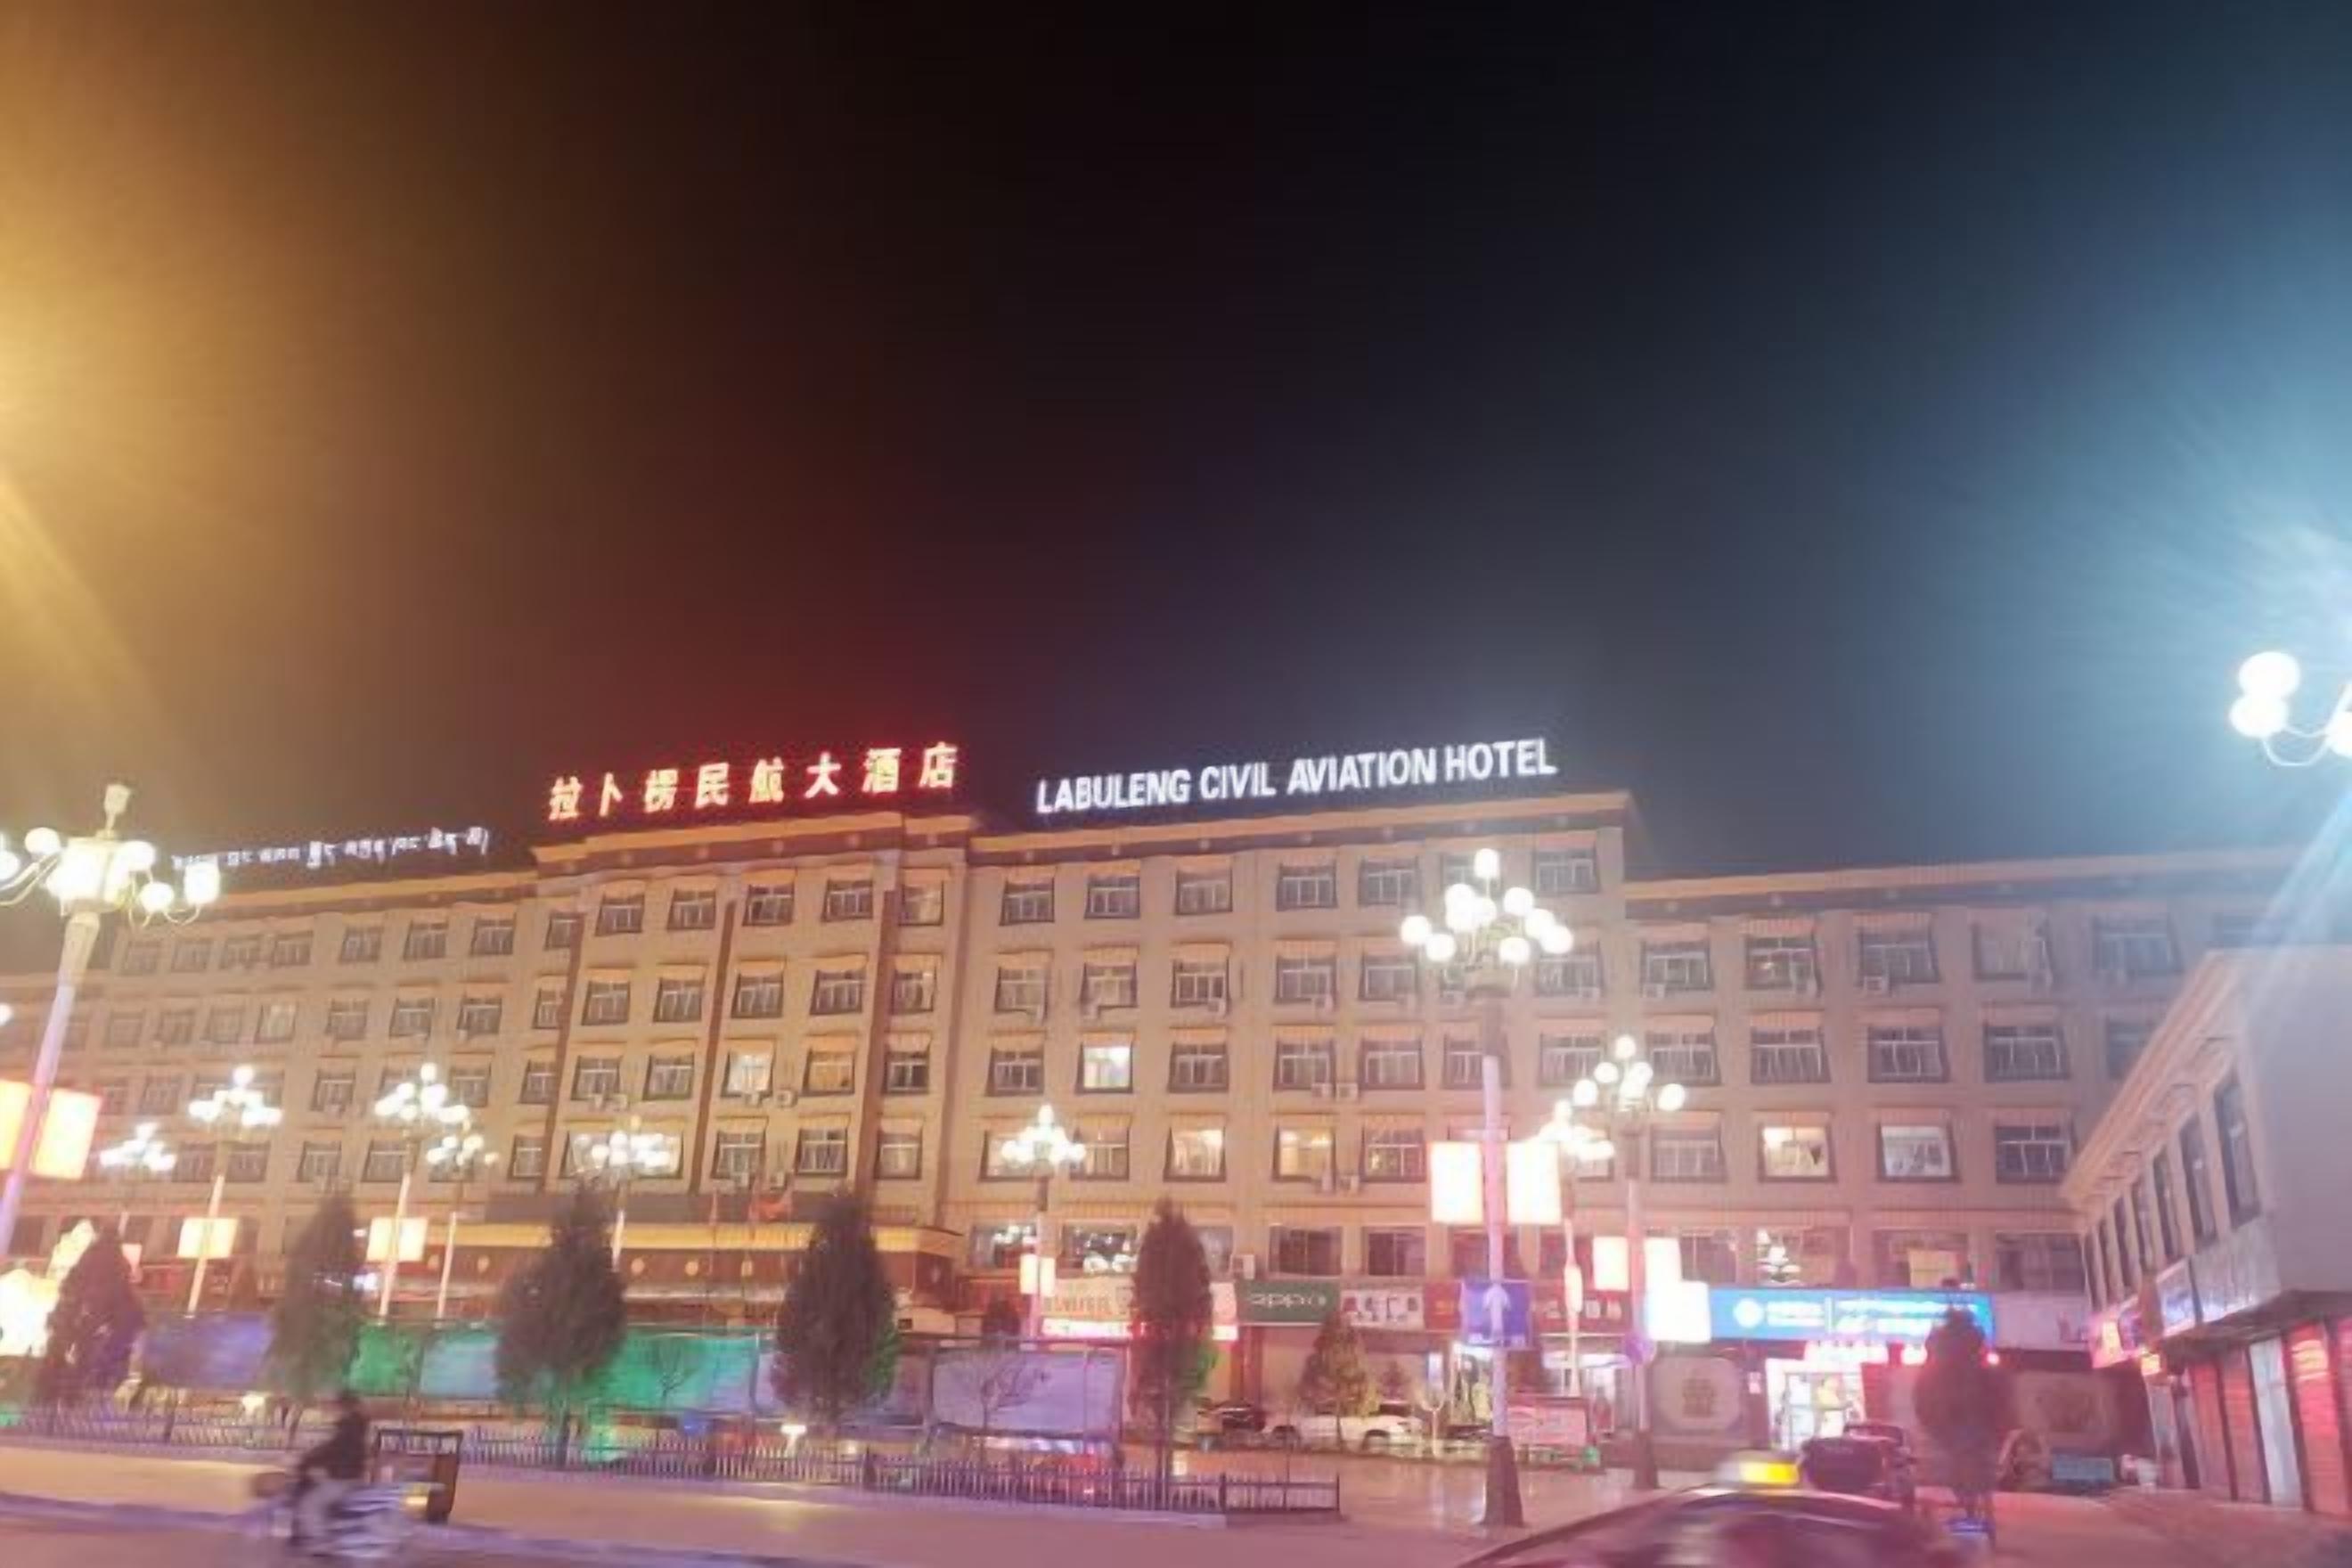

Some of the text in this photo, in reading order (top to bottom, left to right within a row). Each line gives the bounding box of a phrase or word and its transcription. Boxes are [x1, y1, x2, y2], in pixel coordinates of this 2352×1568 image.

[547, 742, 959, 821] 拉卜楞民航大酒店
[1038, 738, 1557, 813] LABULENG CIVIL AVIATION HOTEL
